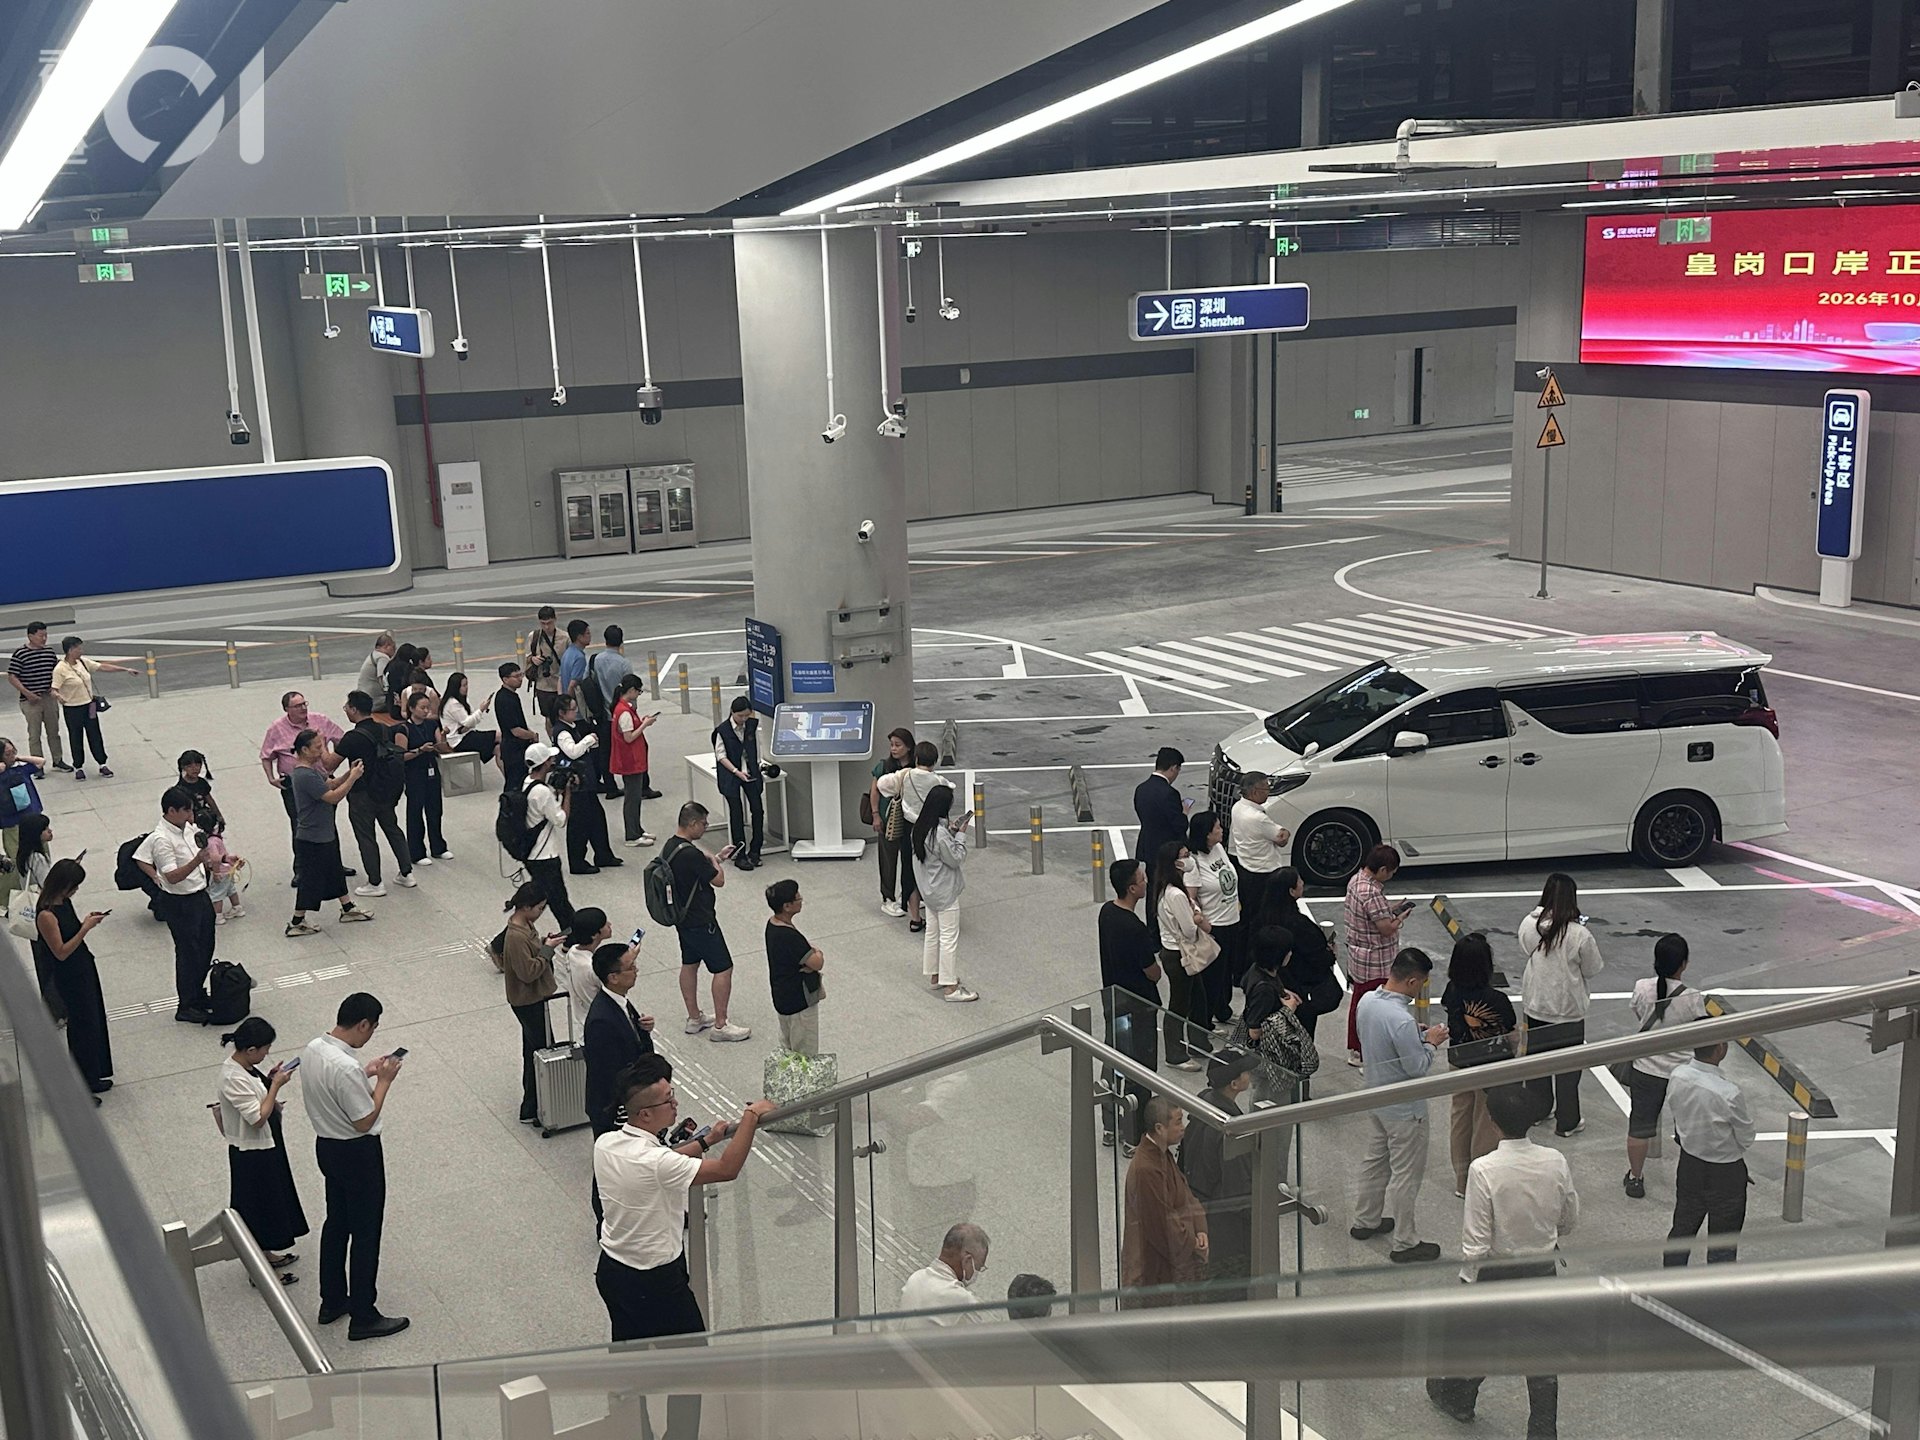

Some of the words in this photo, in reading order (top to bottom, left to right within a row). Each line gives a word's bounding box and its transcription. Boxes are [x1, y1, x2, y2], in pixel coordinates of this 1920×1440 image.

[1685, 250, 1920, 276] 皇岗口岸正
[1200, 297, 1225, 314] 深圳
[1818, 291, 1920, 306] 2026年10
[1175, 303, 1192, 325] 深
[1200, 315, 1244, 328] Shenzhen
[1836, 436, 1852, 488] 上客区
[1824, 477, 1835, 505] Area
